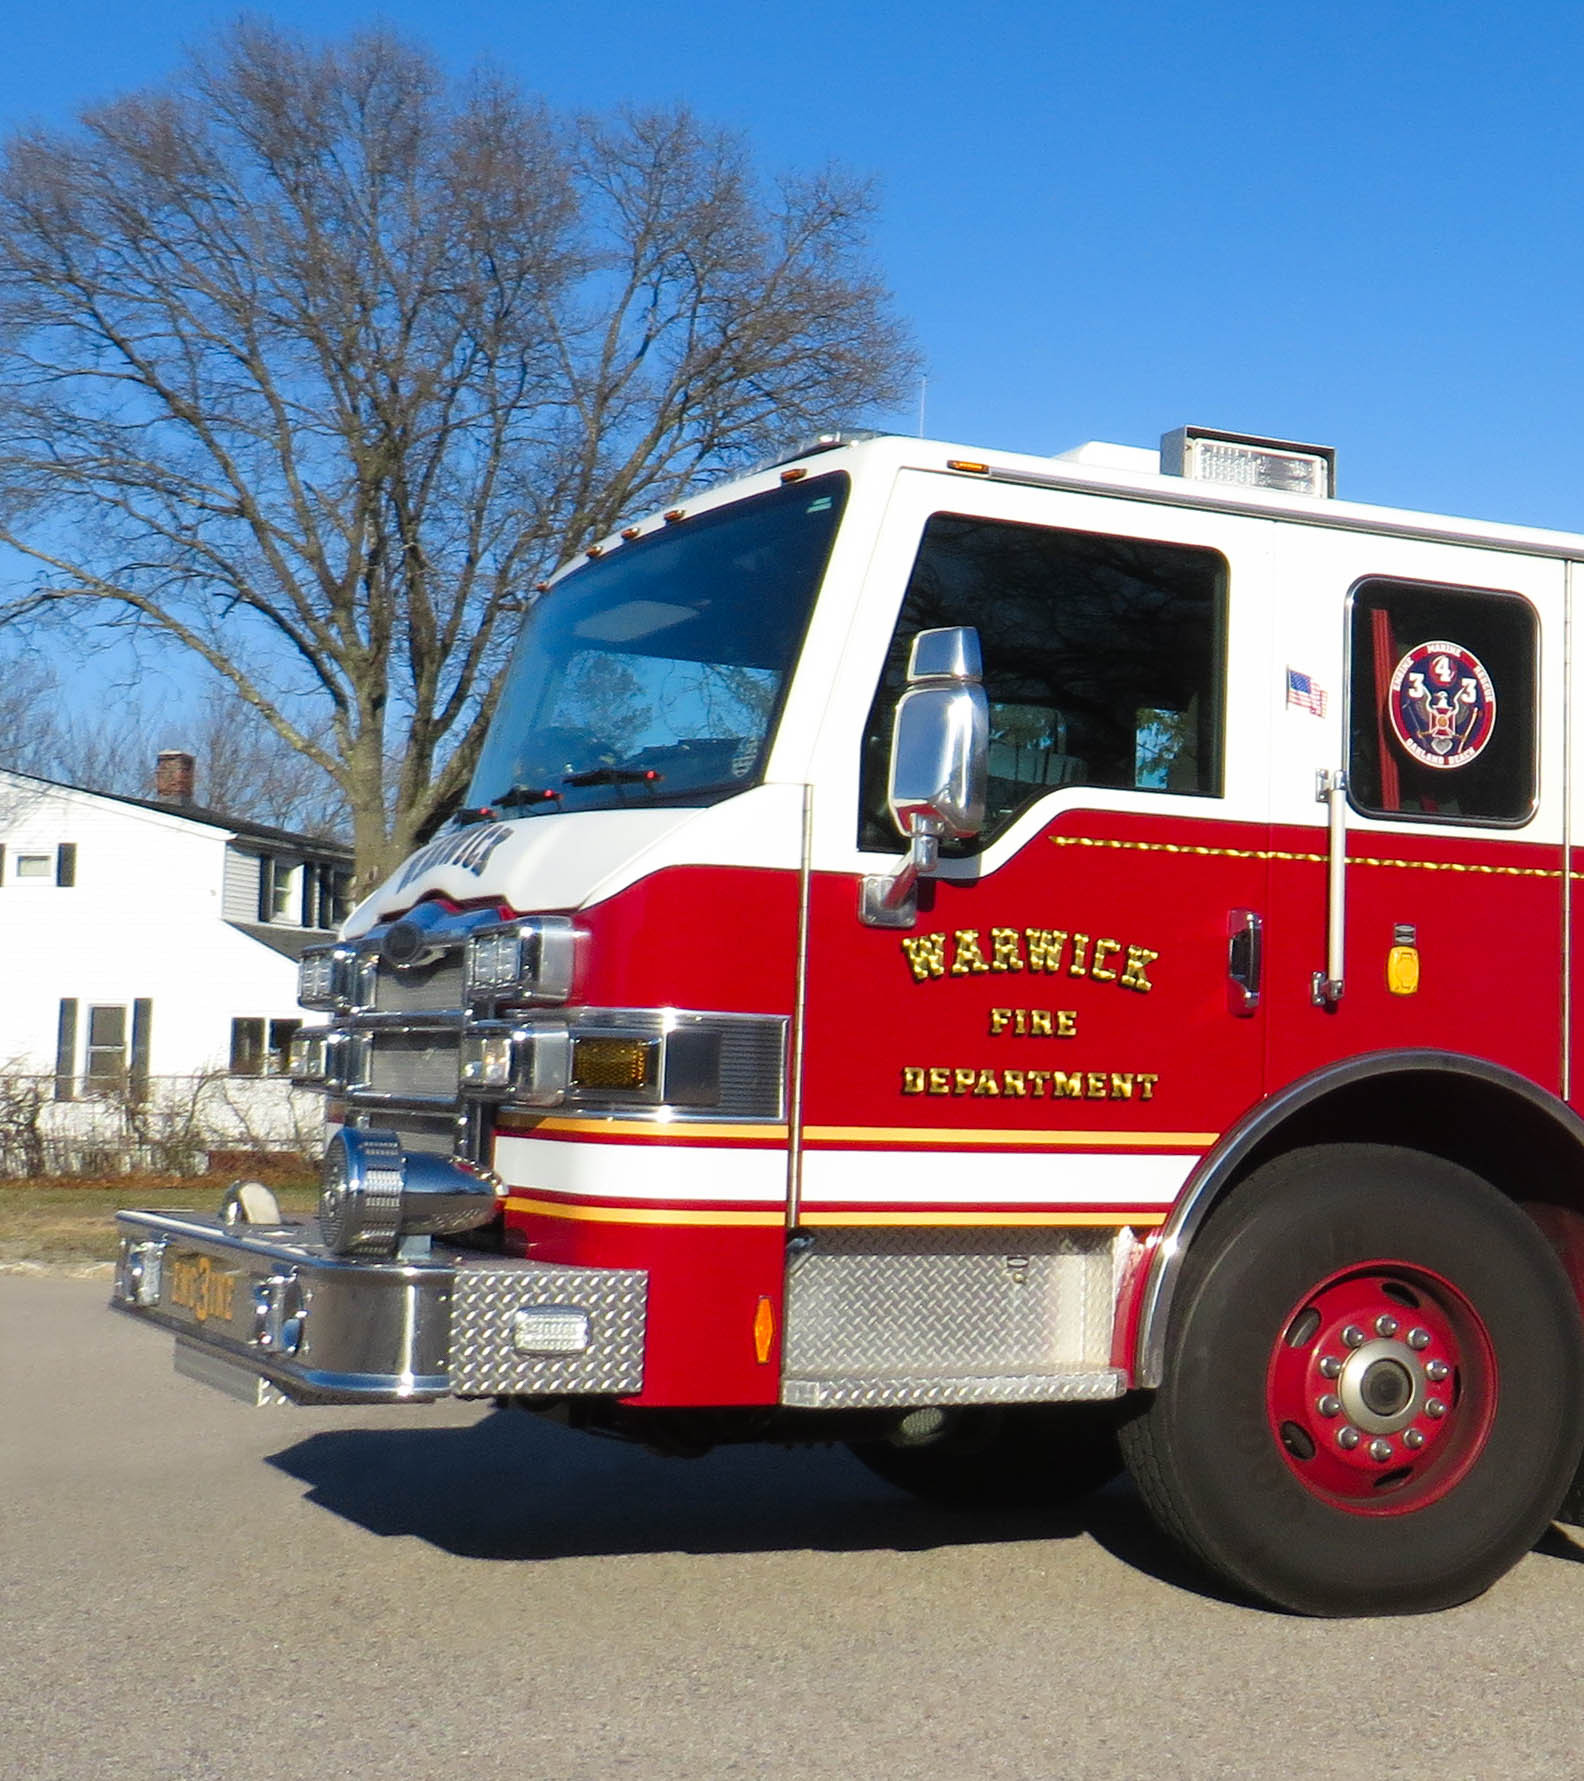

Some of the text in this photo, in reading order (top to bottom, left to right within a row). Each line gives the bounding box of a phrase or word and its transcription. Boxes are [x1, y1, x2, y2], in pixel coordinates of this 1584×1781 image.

[1434, 655, 1453, 682] 4
[1408, 672, 1425, 698] 3
[1461, 678, 1477, 703] 3
[902, 927, 1159, 992] WARWICK
[989, 1008, 1078, 1037] FIRE
[902, 1066, 1159, 1099] DEPARTMENT
